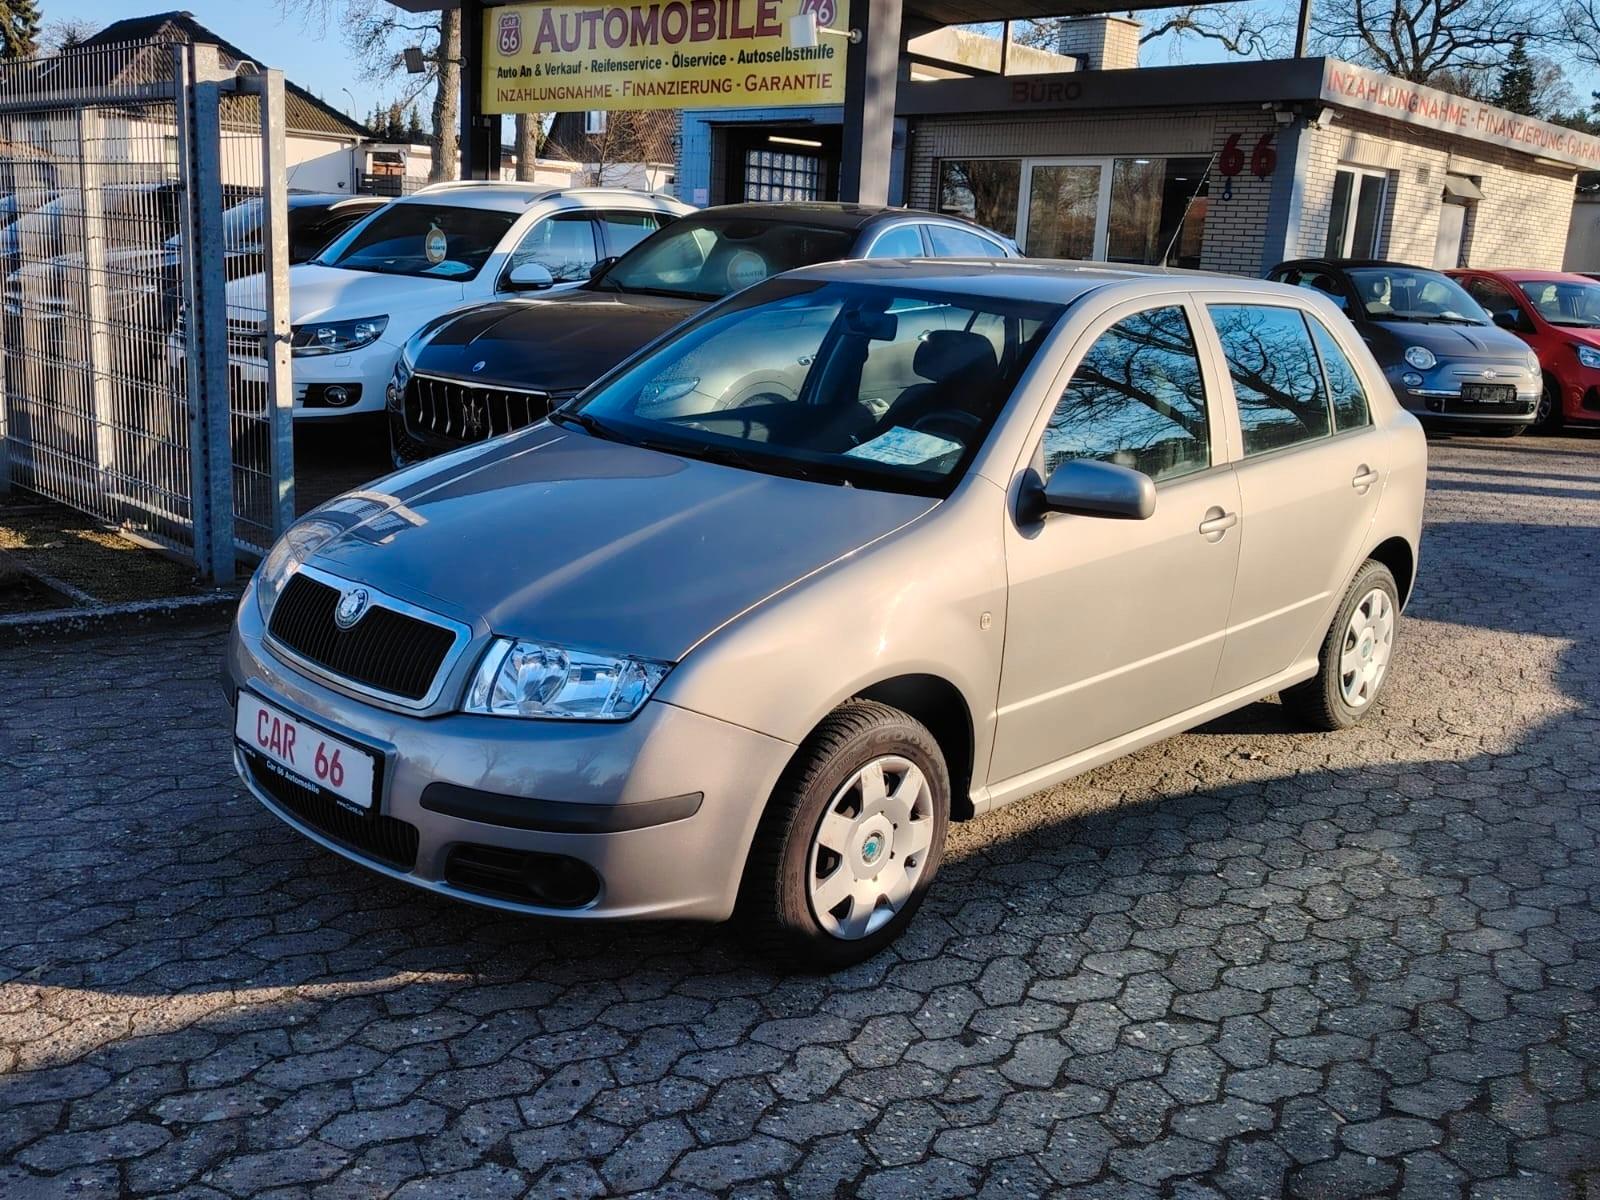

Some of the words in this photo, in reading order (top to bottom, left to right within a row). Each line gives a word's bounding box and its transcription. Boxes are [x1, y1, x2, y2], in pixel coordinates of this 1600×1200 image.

[502, 30, 518, 50] 66
[532, 0, 783, 54] AUTOMOBILE
[497, 67, 517, 79] Auto
[520, 65, 532, 77] An
[535, 64, 541, 76] &
[544, 61, 582, 76] Verkauf
[591, 57, 662, 73] Reifenservice
[672, 51, 726, 69] Ölservice
[737, 43, 834, 65] Autoselbsthilfe
[497, 85, 612, 102] INZAHLUNGNAHME
[622, 78, 732, 96] FINANZIERUNG
[744, 74, 832, 92] GARANTIE
[1012, 79, 1082, 103] BÜRO
[1327, 65, 1469, 127] INZAHLUNGNAHME
[1476, 107, 1563, 152] FINANZIERUNG
[1220, 132, 1276, 177] 66
[257, 709, 296, 766] CAR
[314, 741, 344, 788] 66
[266, 760, 277, 772] Car
